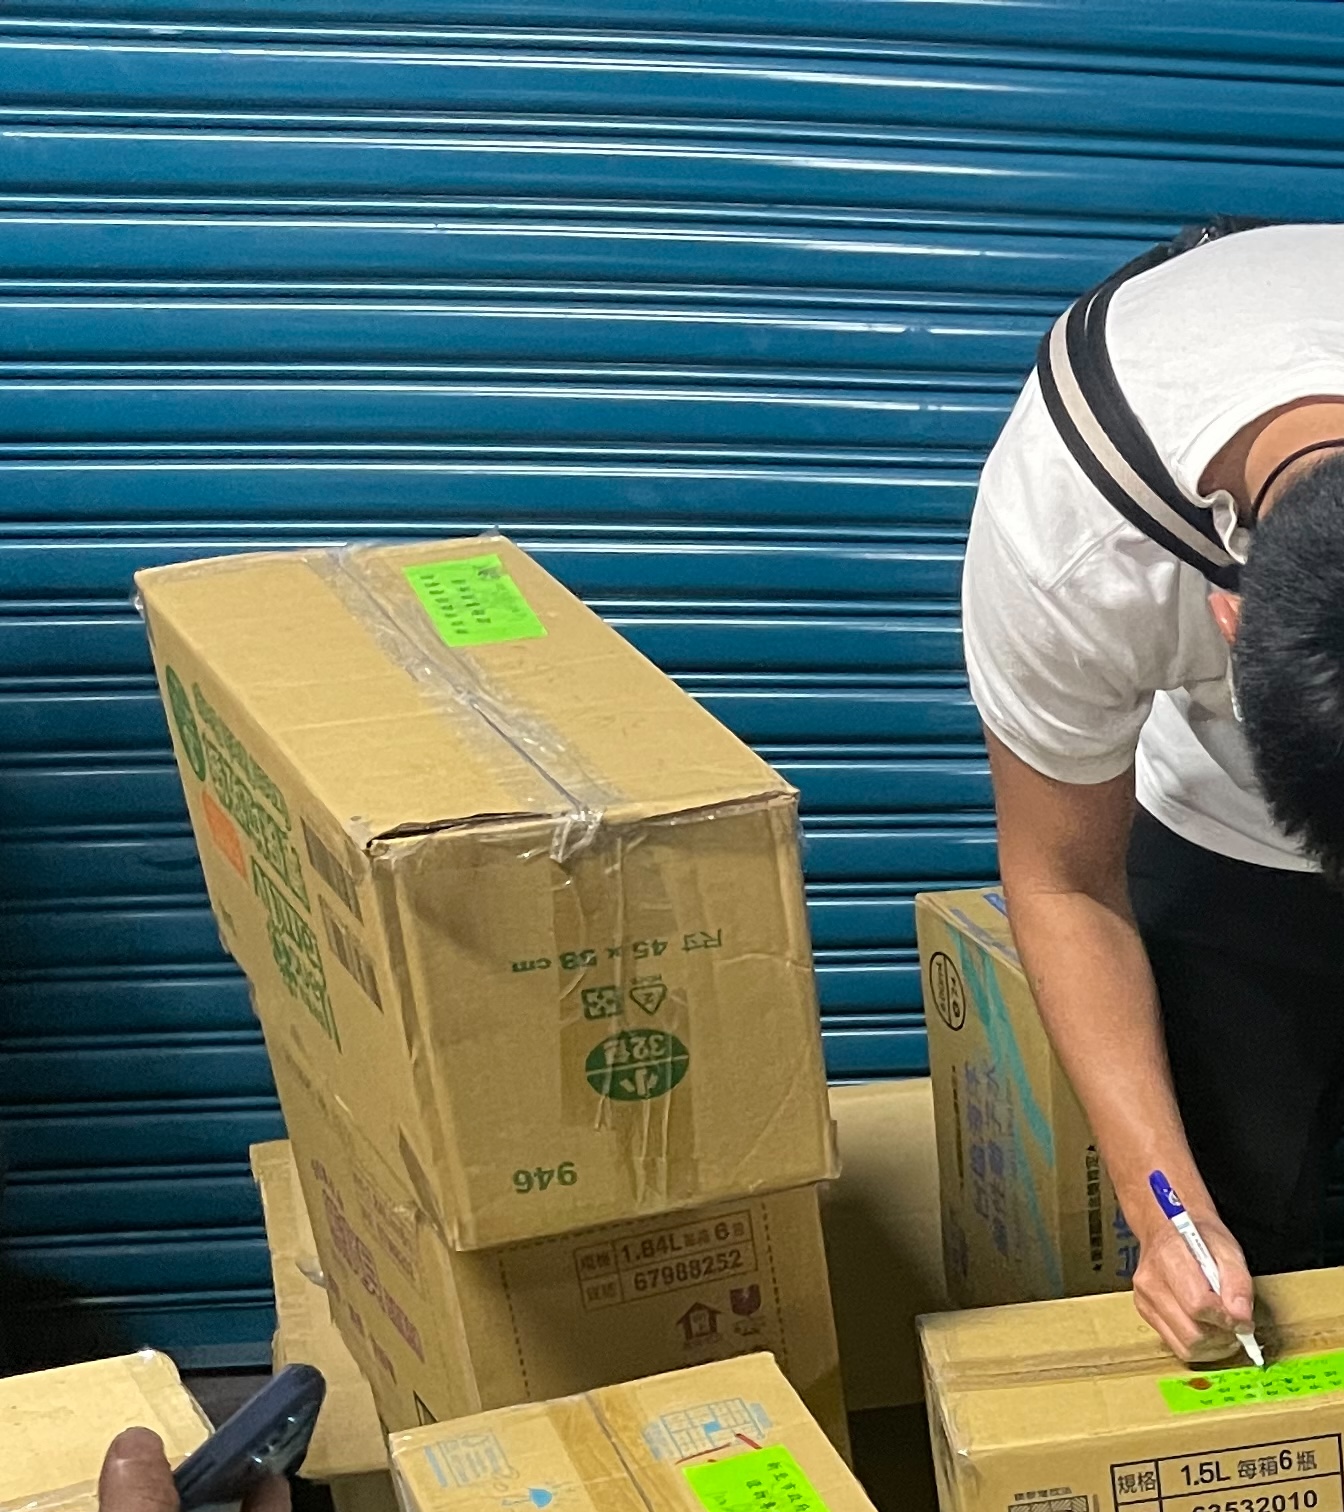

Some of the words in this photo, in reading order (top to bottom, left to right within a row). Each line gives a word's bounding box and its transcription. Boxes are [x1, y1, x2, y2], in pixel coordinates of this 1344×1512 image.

[512, 1160, 578, 1194] 946
[1117, 1470, 1157, 1495] 規格
[1180, 1461, 1231, 1487] 1.5L
